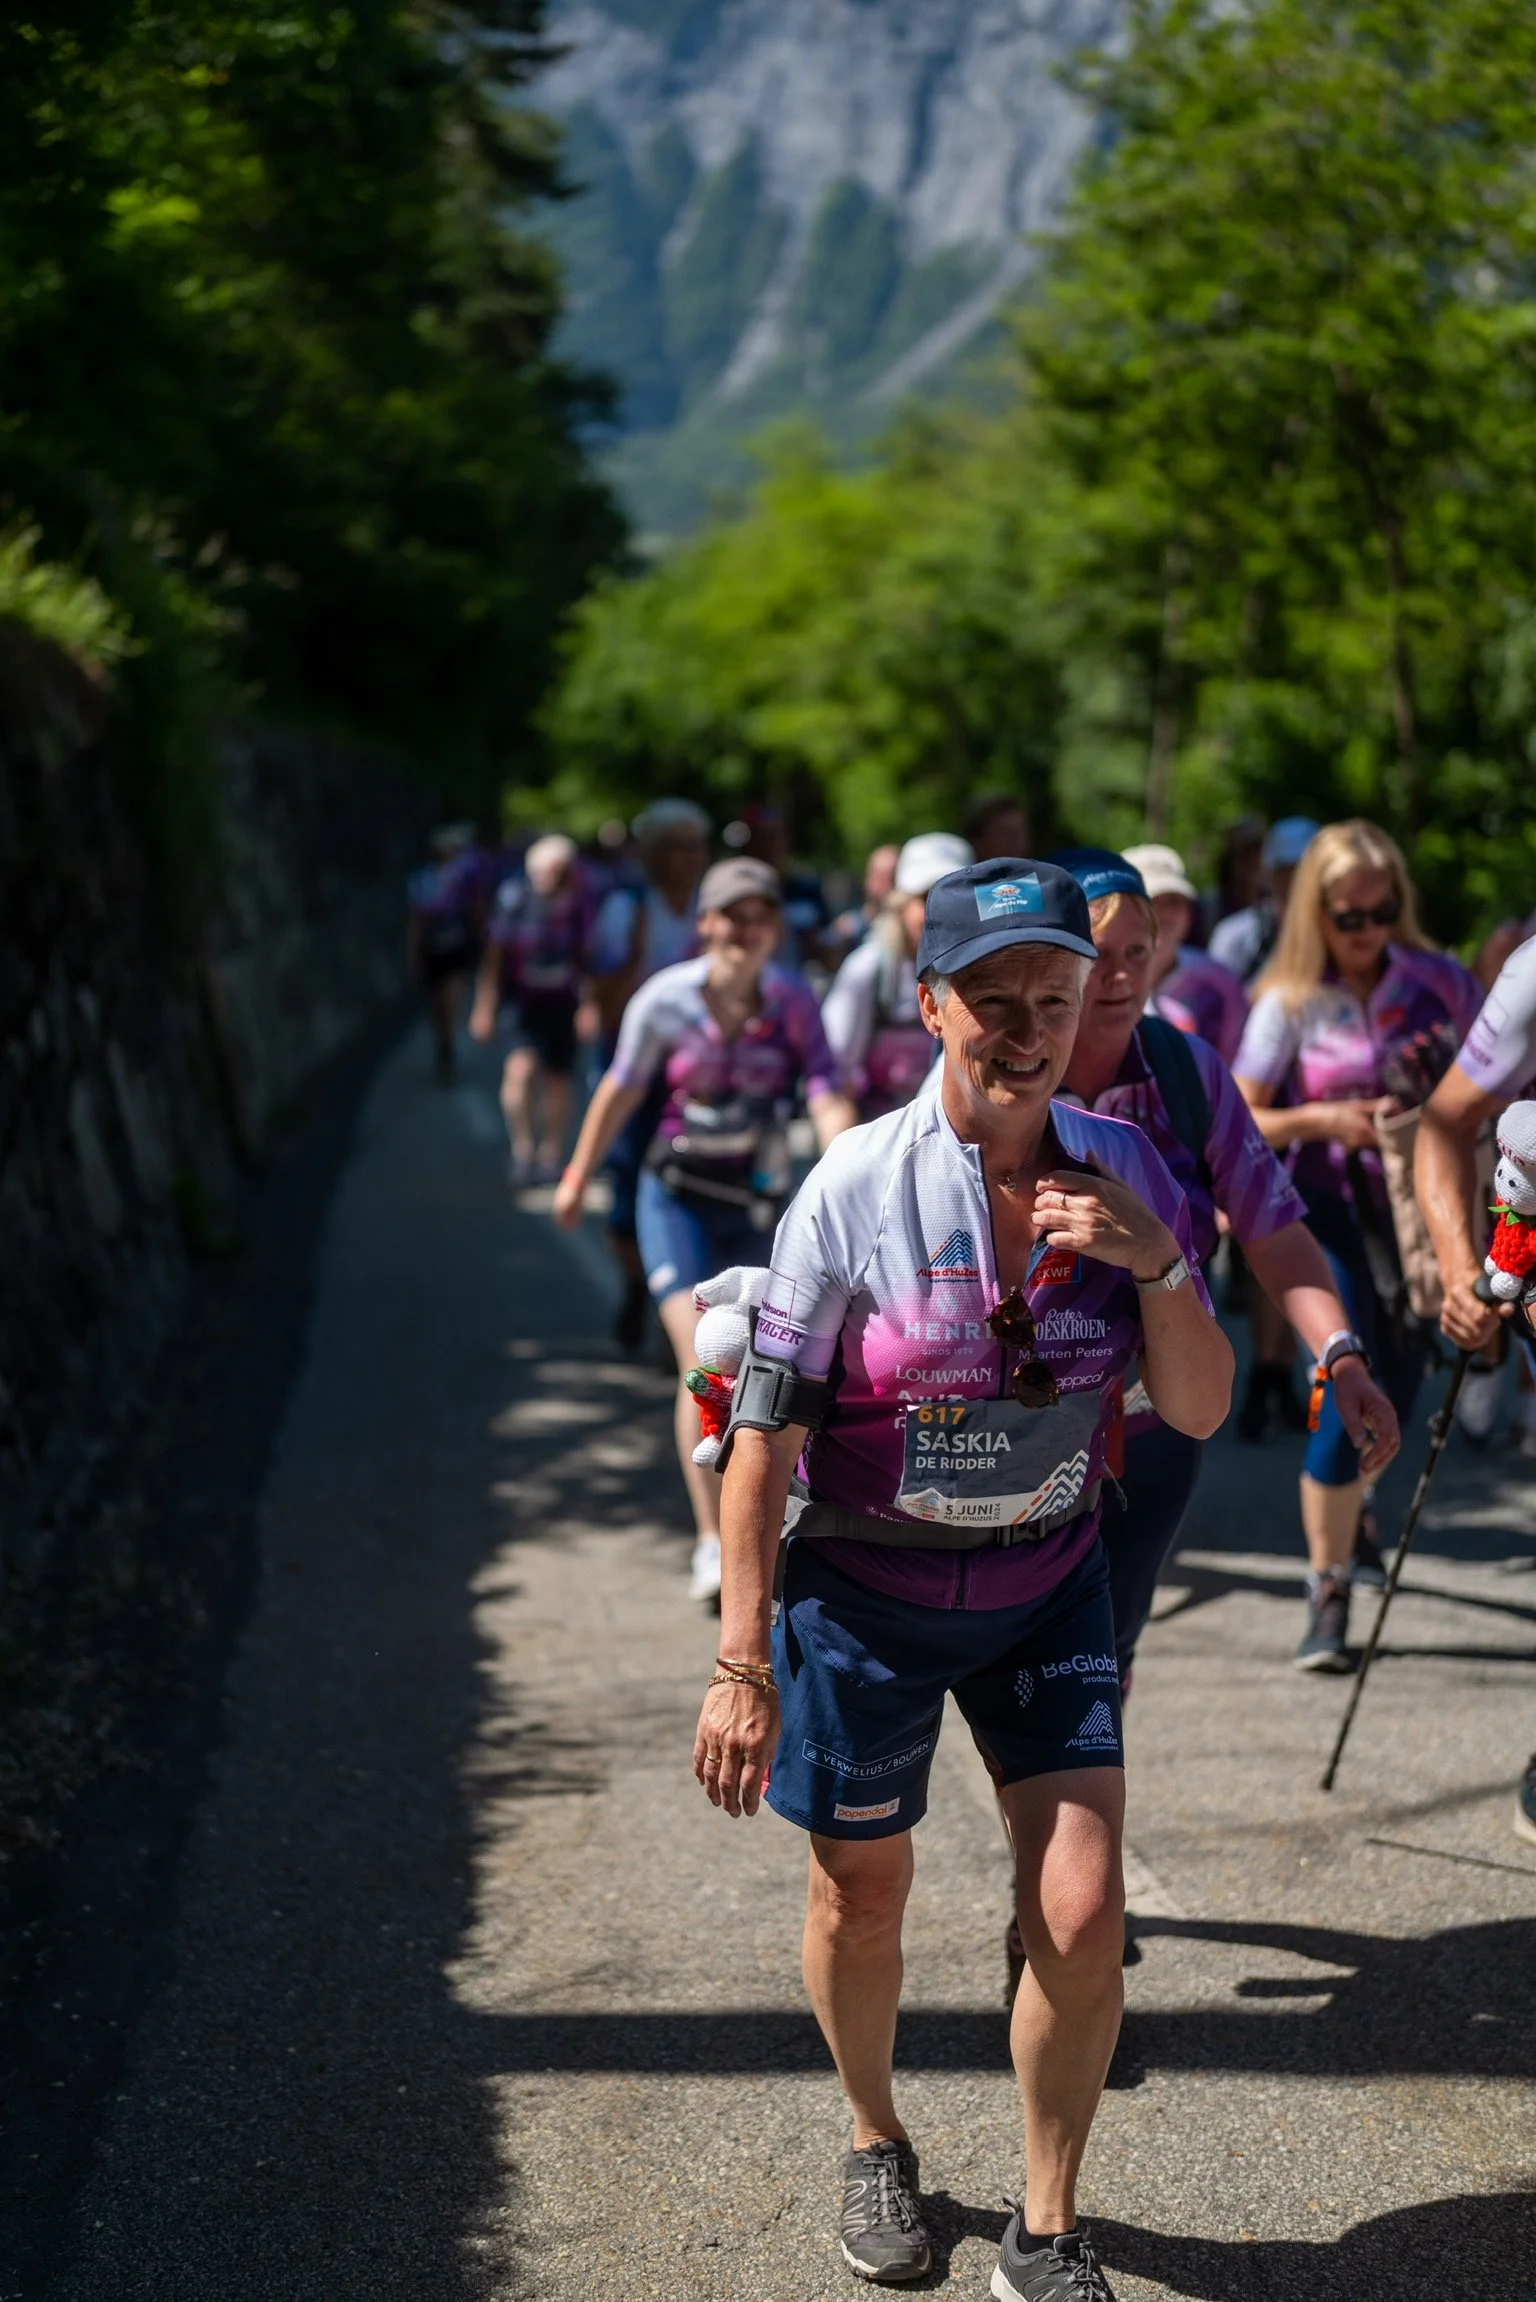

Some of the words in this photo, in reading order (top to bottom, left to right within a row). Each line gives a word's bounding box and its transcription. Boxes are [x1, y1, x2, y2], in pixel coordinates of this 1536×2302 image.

[916, 1268, 940, 1278] Alpe
[1042, 1266, 1071, 1279] KWF
[1045, 1308, 1084, 1323] Pater
[1034, 1319, 1106, 1341] OESKROEN
[921, 1347, 950, 1356] SINDS
[1018, 1349, 1072, 1360] Marten
[1075, 1347, 1113, 1359] Peters
[895, 1364, 993, 1384] LOUWMAN
[918, 1404, 966, 1425] 617
[916, 1430, 1012, 1454] SASKIA
[915, 1456, 936, 1469] DE
[940, 1457, 997, 1470] RIDDER
[945, 1504, 954, 1515] 5
[957, 1503, 993, 1515] JUNI
[993, 1502, 1001, 1520] 2024
[1082, 1675, 1112, 1685] product
[1065, 1738, 1090, 1748] Alpe
[837, 1804, 887, 1819] papendal
